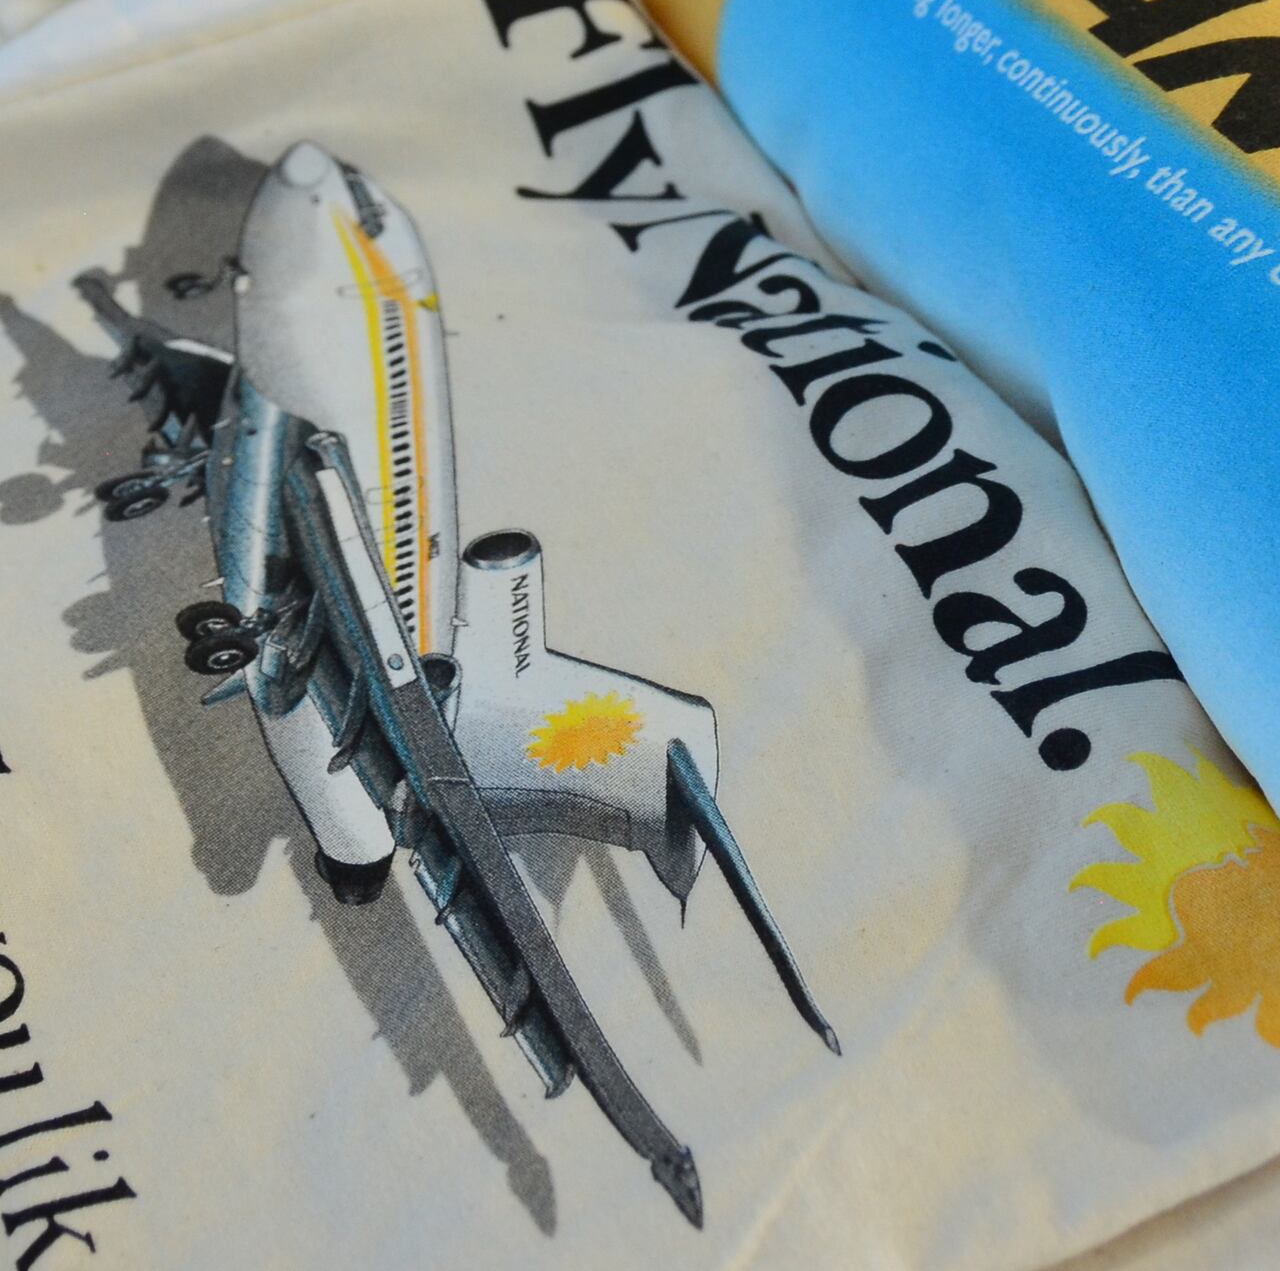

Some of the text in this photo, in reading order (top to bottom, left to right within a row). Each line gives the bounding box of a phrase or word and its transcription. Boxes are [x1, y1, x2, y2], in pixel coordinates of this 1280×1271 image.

[996, 49, 1151, 180] continuously,
[1144, 162, 1215, 224] than
[1208, 206, 1276, 267] any
[609, 209, 1184, 772] National.
[510, 573, 531, 679] NATIONAL
